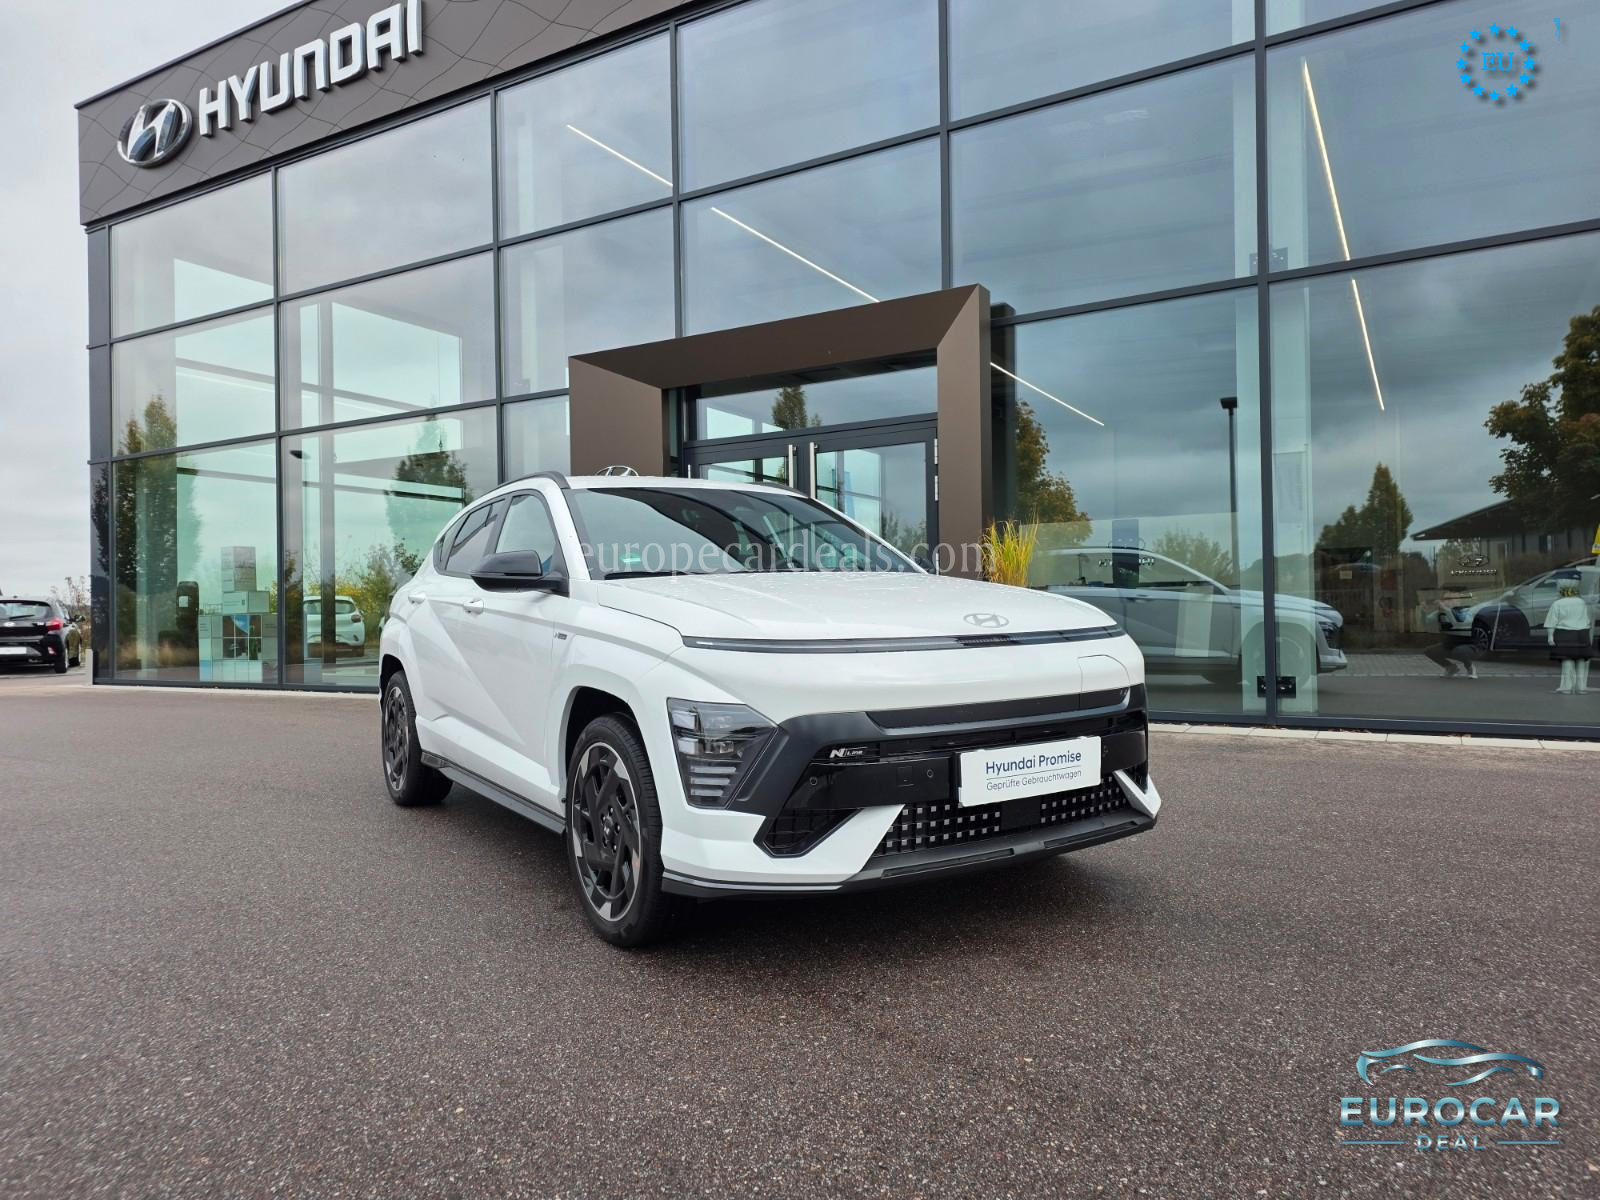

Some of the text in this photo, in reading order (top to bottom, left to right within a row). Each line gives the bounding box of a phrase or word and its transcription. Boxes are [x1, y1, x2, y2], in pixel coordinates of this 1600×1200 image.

[198, 0, 424, 138] HYUNDAI
[985, 750, 1082, 776] Hyundai Promise
[986, 769, 1082, 791] Geprüfte Gebrauchtwagen
